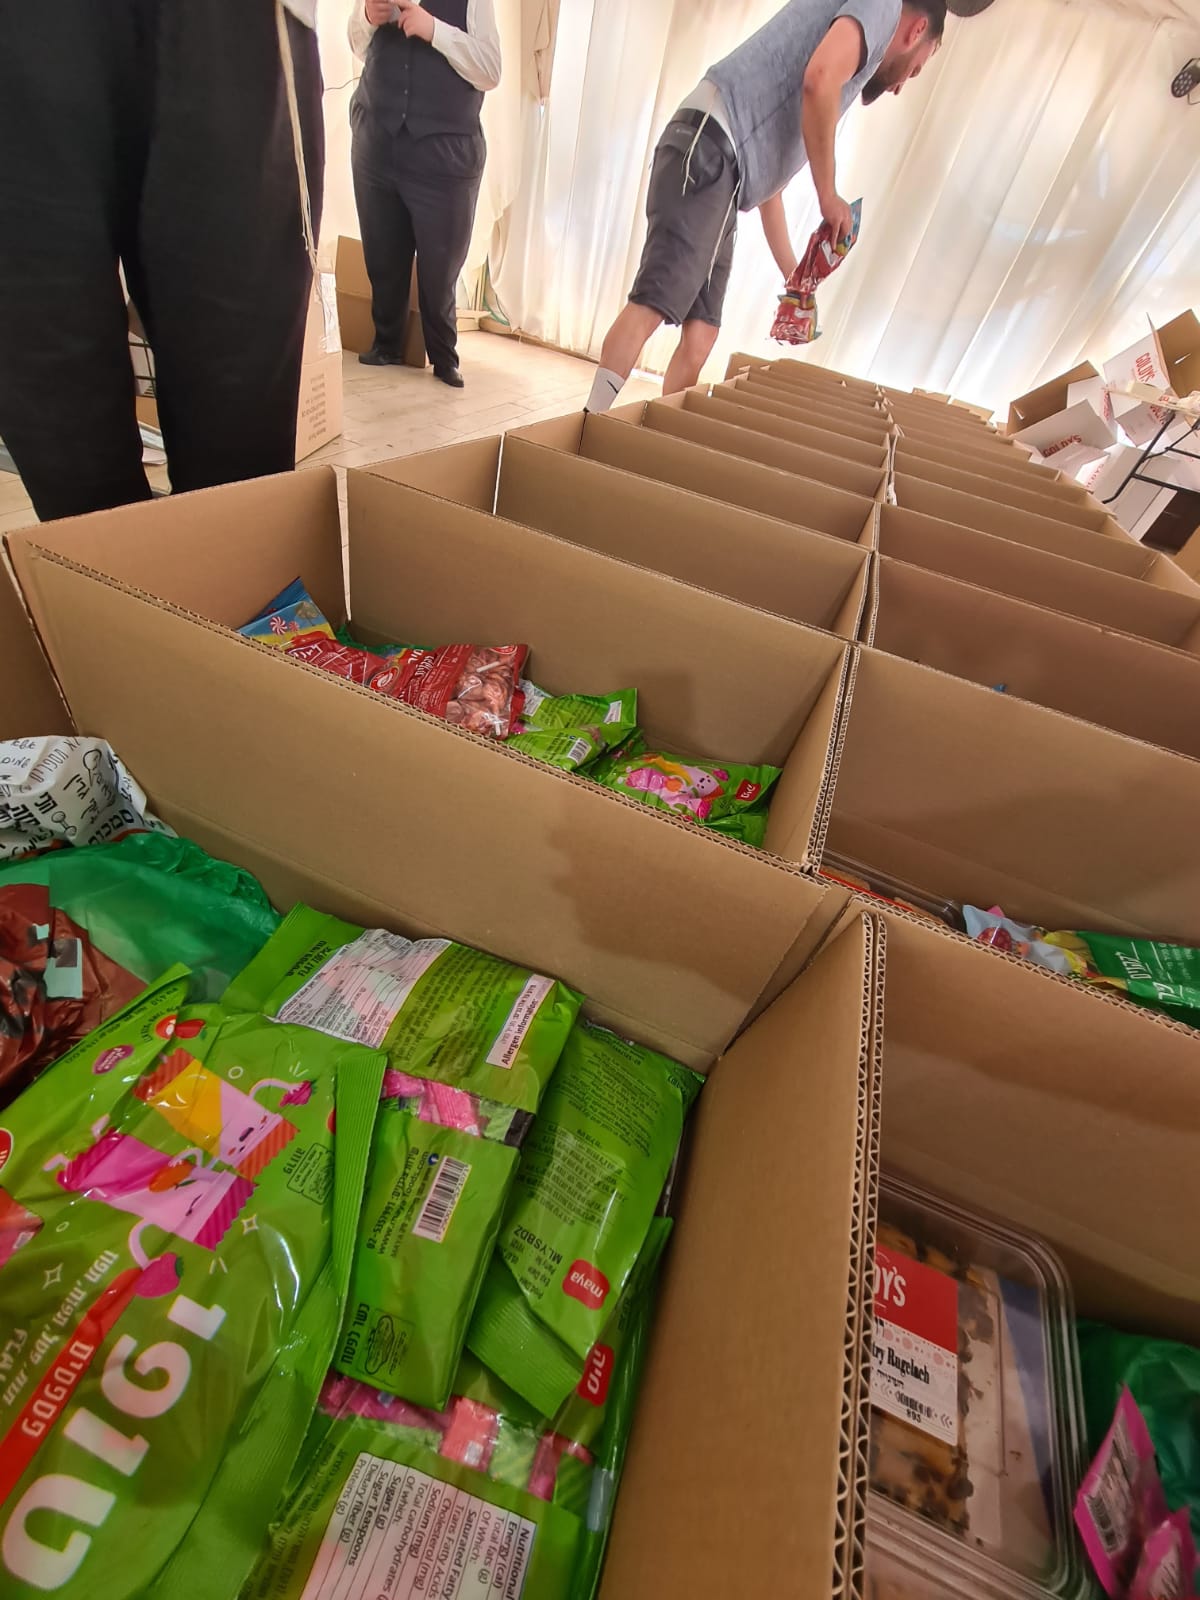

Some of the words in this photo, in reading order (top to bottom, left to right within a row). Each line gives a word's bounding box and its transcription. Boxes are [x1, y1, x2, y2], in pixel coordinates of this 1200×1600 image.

[500, 1033, 521, 1065] Allergen
[512, 1223, 564, 1265] MLYSBDZ
[568, 1267, 605, 1299] maya
[351, 1300, 371, 1330] כשר
[339, 1328, 362, 1366] לפסח
[887, 1343, 931, 1386] Rugelach
[16, 1335, 96, 1442] פספסים
[1, 1294, 227, 1591] טופי
[341, 1457, 367, 1501] Proteins
[354, 1462, 379, 1500] Dietary
[367, 1469, 390, 1503] Sugar
[378, 1473, 403, 1514] Sugars
[404, 1474, 417, 1492] Of
[411, 1480, 429, 1510] Total
[347, 1498, 366, 1528] fiber
[372, 1512, 389, 1531] (g)
[418, 1485, 442, 1531] Sodium
[446, 1502, 466, 1536] Trans
[479, 1509, 492, 1527] Of
[338, 1525, 355, 1545] (g)
[345, 1502, 378, 1568] Teaspoons
[406, 1528, 427, 1560] (mg)
[423, 1495, 453, 1562] Cholesterol
[451, 1508, 479, 1568] Saturated
[467, 1525, 488, 1565] Which:
[489, 1514, 505, 1545] Total
[495, 1519, 519, 1562] Energy
[379, 1508, 420, 1594] carbohydrates
[435, 1534, 456, 1566] Fatty
[482, 1543, 498, 1568] fats
[503, 1526, 531, 1600] Nutritional
[411, 1559, 431, 1592] (mg)
[425, 1565, 445, 1600] Acids
[439, 1567, 460, 1600] Fatty
[475, 1565, 491, 1586] (g)
[490, 1560, 508, 1590] (cal)
